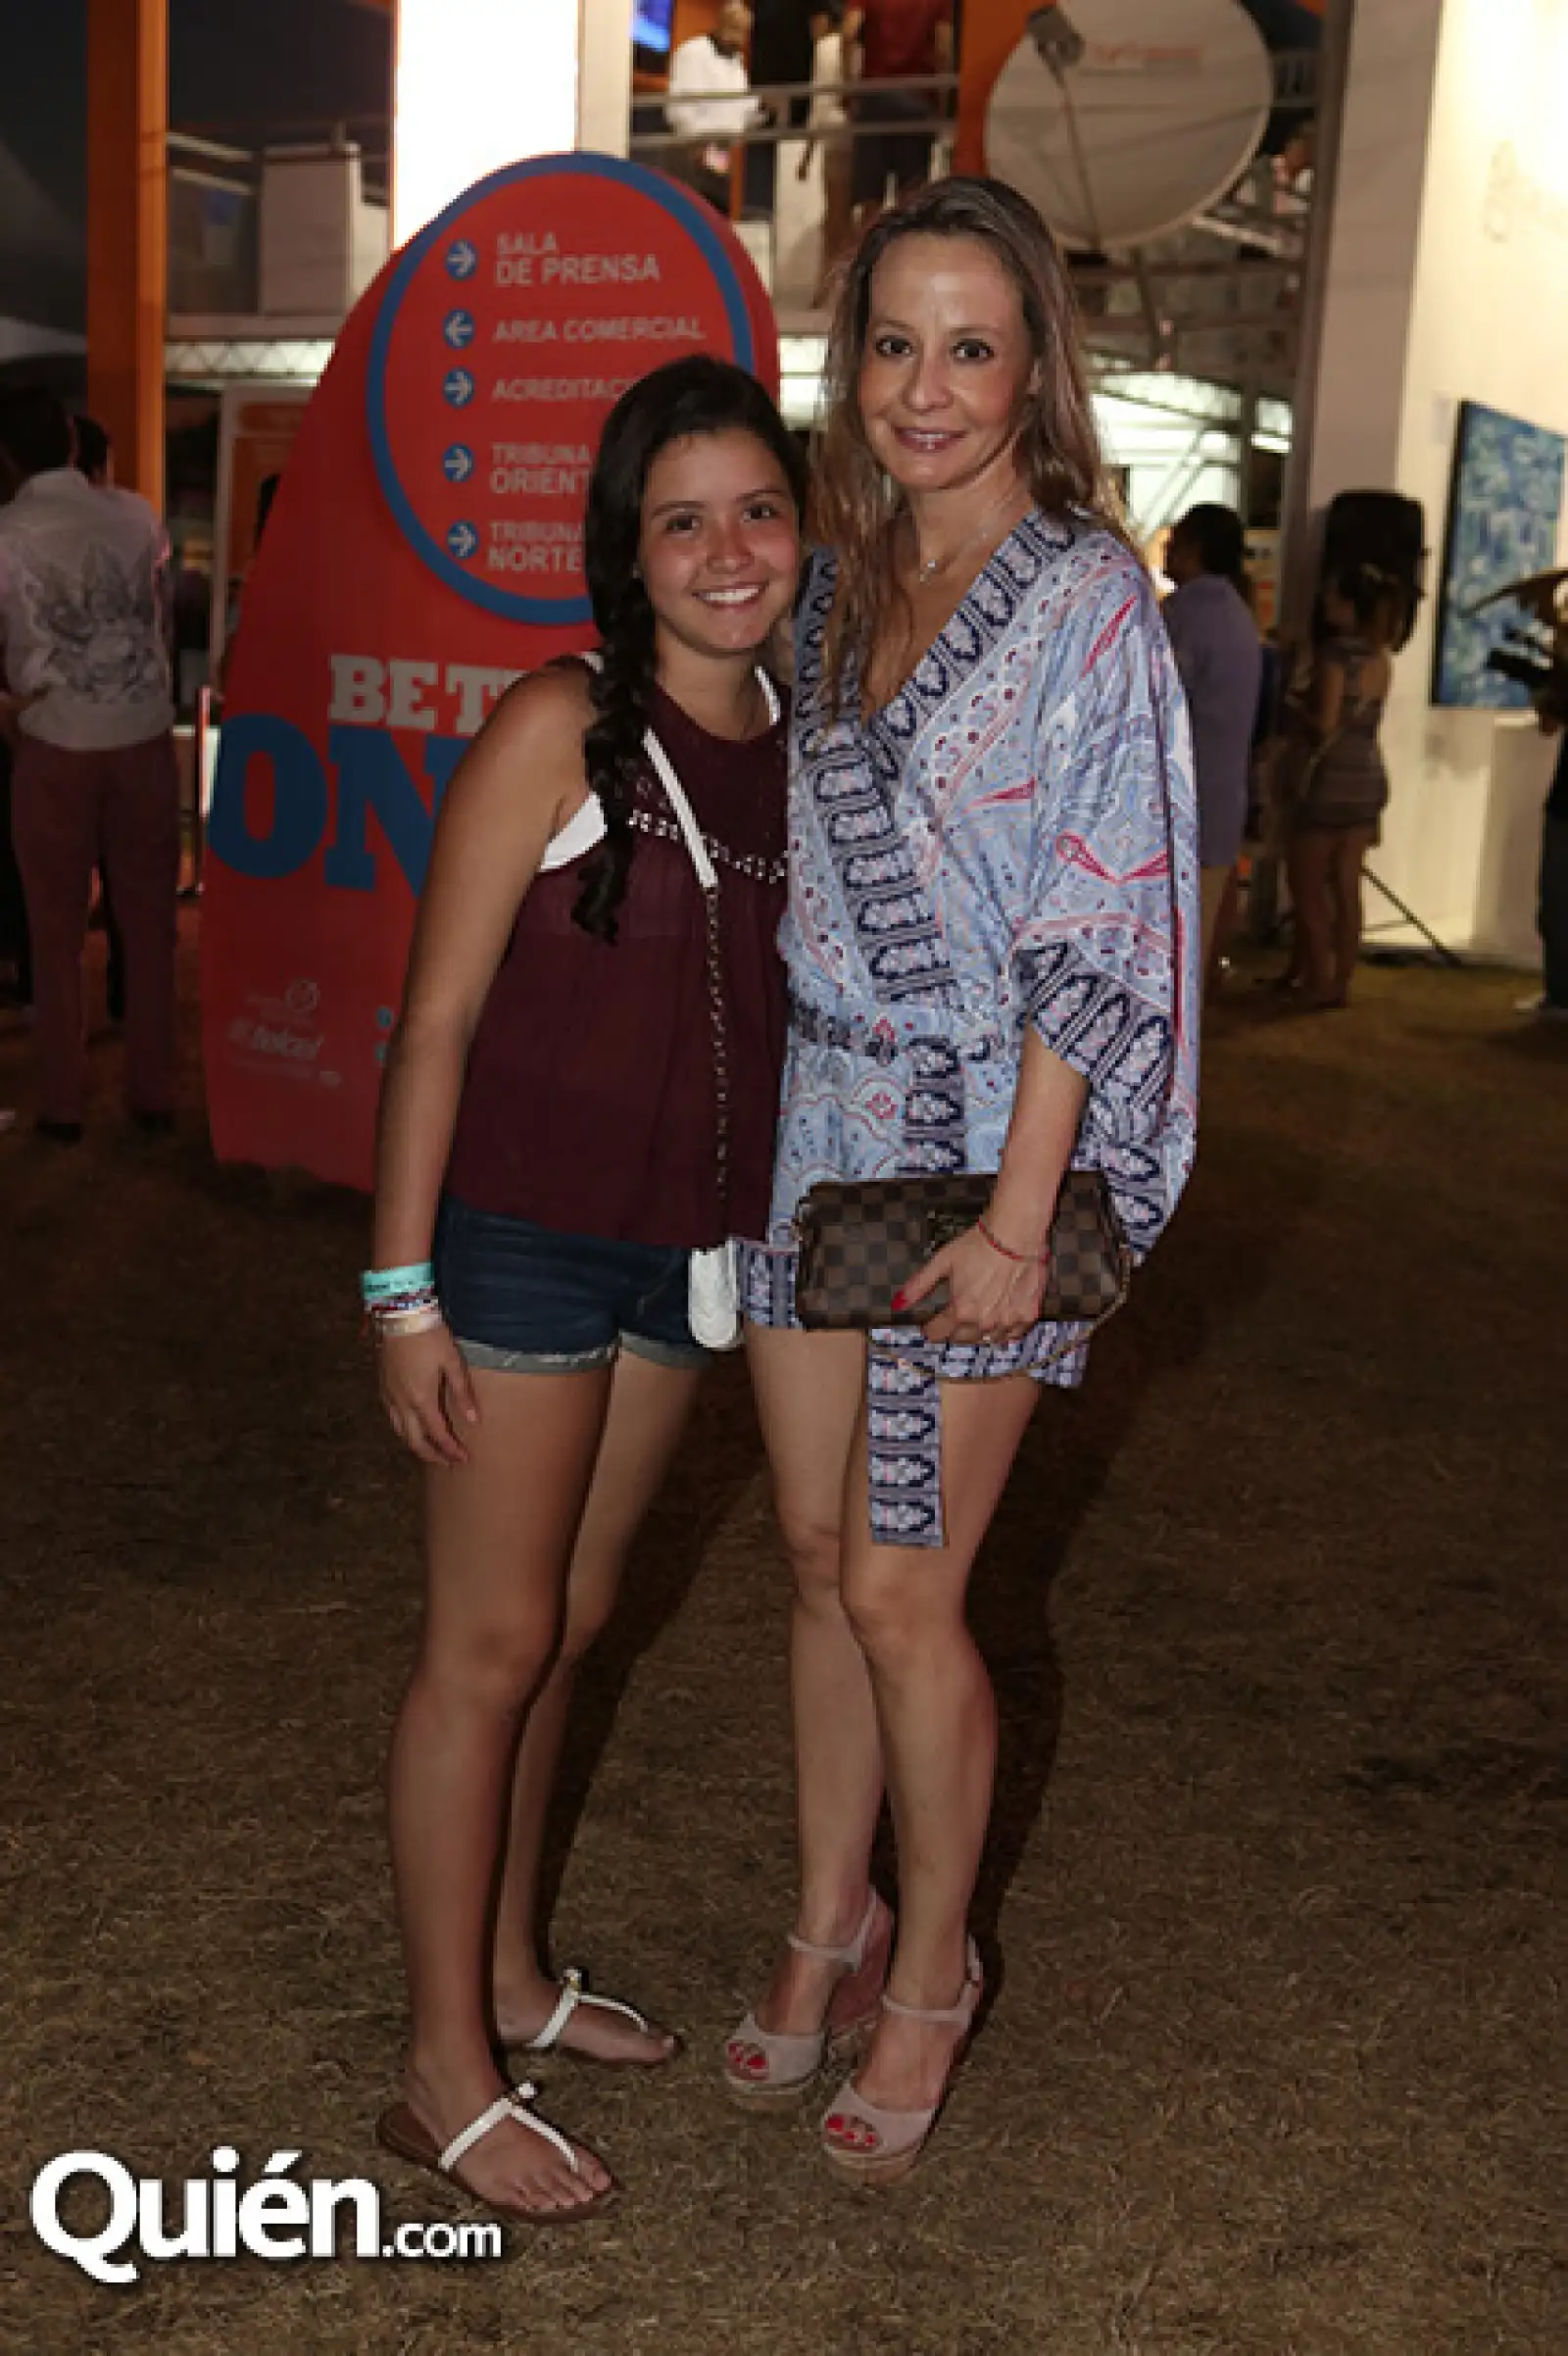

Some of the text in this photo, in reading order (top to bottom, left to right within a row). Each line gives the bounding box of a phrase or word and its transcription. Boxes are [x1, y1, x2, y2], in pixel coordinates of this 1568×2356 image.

[497, 232, 559, 255] SALA
[495, 253, 661, 287] DE PRENSA
[492, 315, 707, 343] AREA COMERCIAL
[492, 376, 636, 403] ACREDITAC
[492, 442, 591, 466] TRIBUNA
[490, 467, 590, 494] ORIENT
[487, 544, 586, 572] NORTE
